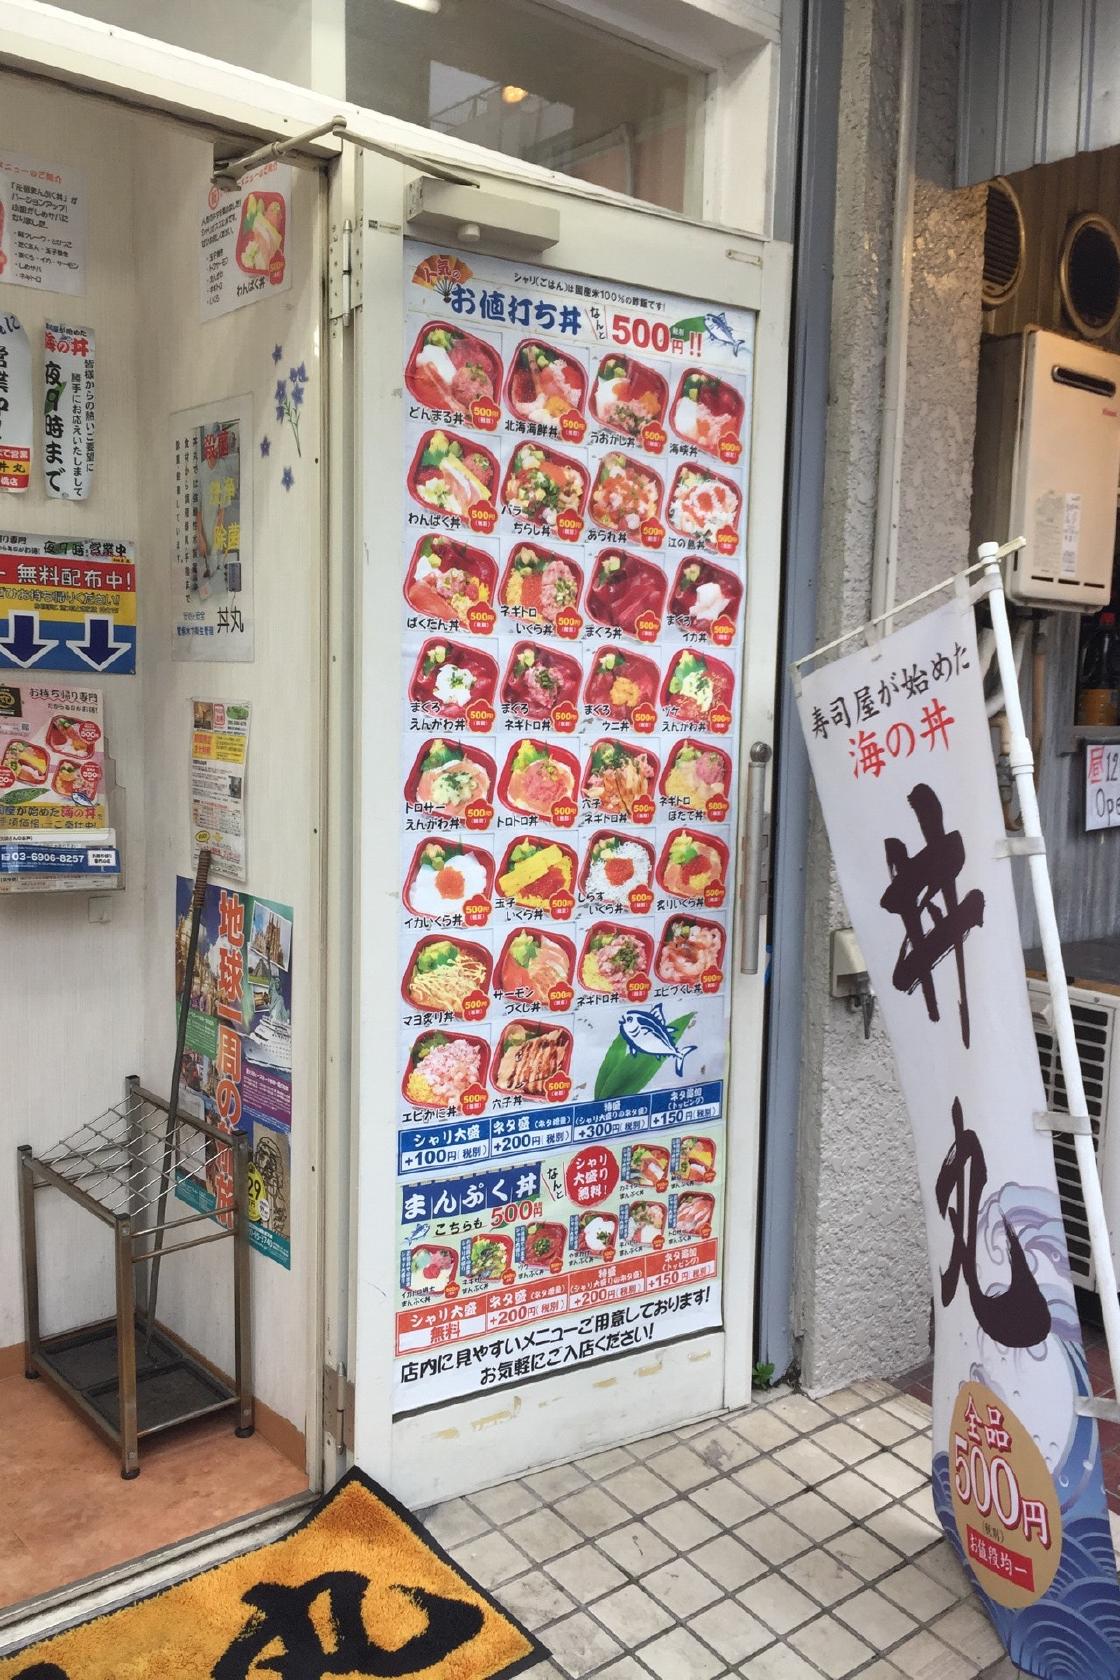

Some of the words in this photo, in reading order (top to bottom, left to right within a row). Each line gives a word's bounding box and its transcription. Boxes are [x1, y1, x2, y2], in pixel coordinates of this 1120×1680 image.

[451, 284, 582, 335] お値打ち丼
[590, 306, 607, 341] なんと
[410, 406, 464, 425] どんまる丼
[505, 420, 560, 438] 北海海鮮丼
[501, 504, 522, 516] バラ
[408, 512, 461, 528] わんぱく丼
[513, 522, 550, 536] ちらし丼
[587, 530, 627, 543] あられ丼
[668, 537, 705, 550] 江の島丼
[17, 563, 131, 590] 無料配布中!
[501, 606, 537, 617] ネギトロ
[217, 606, 244, 634] 丼丸
[407, 617, 459, 631] ばくだん丼
[666, 615, 692, 626] まぐろ
[516, 624, 552, 635] いくら丼
[585, 627, 622, 639] まぐろ丼
[683, 633, 707, 643] イカ丼
[29, 688, 98, 703] お持ち帰り専門
[811, 641, 970, 740] 寿司屋が始めた
[410, 702, 440, 713] まぐろ
[501, 703, 529, 714] まぐろ
[584, 704, 611, 715] まぐろ
[410, 718, 465, 731] えんがわ丼
[505, 719, 550, 731] ネギトロ丼
[602, 721, 629, 731] ウニ丼
[662, 721, 706, 732] えんがわ丼
[847, 697, 955, 779] 海の丼
[406, 803, 445, 813] トロサー
[582, 799, 600, 809] 穴子
[659, 796, 690, 806] ネギトロ
[497, 816, 538, 827] トロトロ丼
[584, 814, 627, 824] ネギトロ丼
[668, 811, 703, 821] ほたて丼
[406, 819, 459, 831] えんがわ丼
[12, 852, 85, 864] 03-6906-8257
[495, 898, 515, 908] 玉子
[578, 891, 605, 902] しらす
[506, 909, 543, 921] いくら丼
[589, 903, 623, 914] いくら丼
[404, 914, 463, 929] イカいくら丼
[493, 988, 534, 1000] サーモン
[577, 993, 620, 1006] ネギトロ丼
[403, 1011, 454, 1027] マヨ炙り丼
[492, 1095, 522, 1110] 穴子丼
[403, 1105, 457, 1123] エビかに丼
[493, 1116, 530, 1134] ネタ盛
[414, 1124, 480, 1147] シャリ大盛
[575, 1153, 608, 1170] シャリ
[547, 1168, 565, 1200] なんと
[573, 1169, 609, 1186] 大盛り
[404, 1172, 537, 1220] まんぷく丼
[435, 1218, 483, 1237] こちらも
[490, 1289, 527, 1308] ネタ盛
[411, 1302, 477, 1327] シャリ大盛
[401, 1286, 711, 1384] 店内に見やすいメニューご用意しております!
[480, 1323, 655, 1385] お気軽にご入店ください!
[964, 1394, 1012, 1450] 全品
[953, 1432, 1053, 1550] 500円
[968, 1532, 1028, 1577] お値段均一
